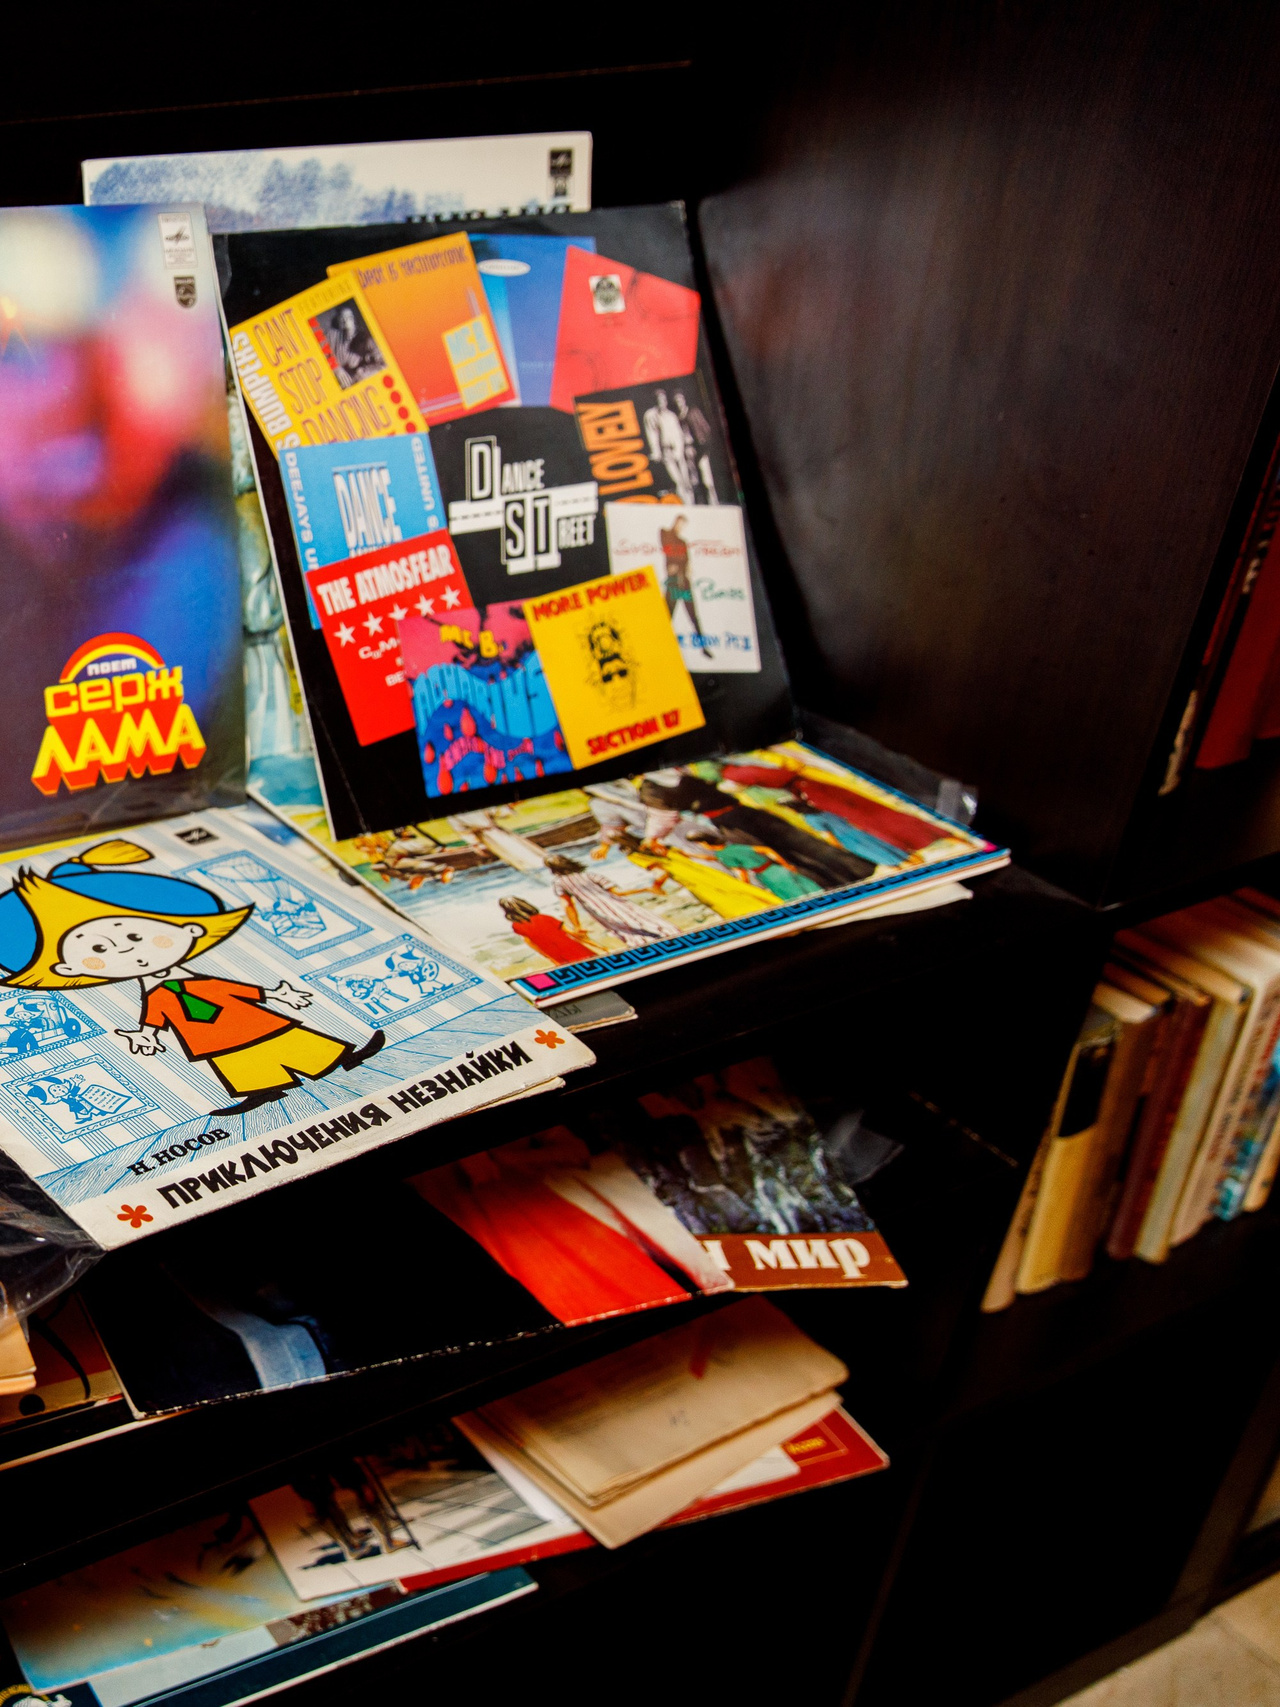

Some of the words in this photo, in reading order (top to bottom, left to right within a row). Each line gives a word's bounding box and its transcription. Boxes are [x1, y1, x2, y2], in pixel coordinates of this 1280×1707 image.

[232, 330, 293, 438] BUMPERS
[277, 356, 328, 415] STOP
[301, 385, 393, 446] DANCING
[410, 436, 436, 512] UNITED
[577, 400, 655, 497] LOVELY
[284, 451, 314, 544] DEEJAYS
[332, 466, 404, 550] DANCE
[316, 576, 357, 616] THE
[354, 543, 456, 605] ATMOSFEAR
[532, 590, 583, 622] MORE
[585, 572, 650, 606] POWER
[31, 702, 208, 797] ЛАМА
[586, 717, 660, 757] SECTION
[126, 1152, 156, 1178] Н.
[154, 1128, 231, 1168] НОСОВ
[156, 1102, 393, 1209] ПРИКЛЮЧЕНИЯ
[387, 1040, 534, 1114] НЕЗНАЙКИ
[743, 1237, 871, 1280] мир
